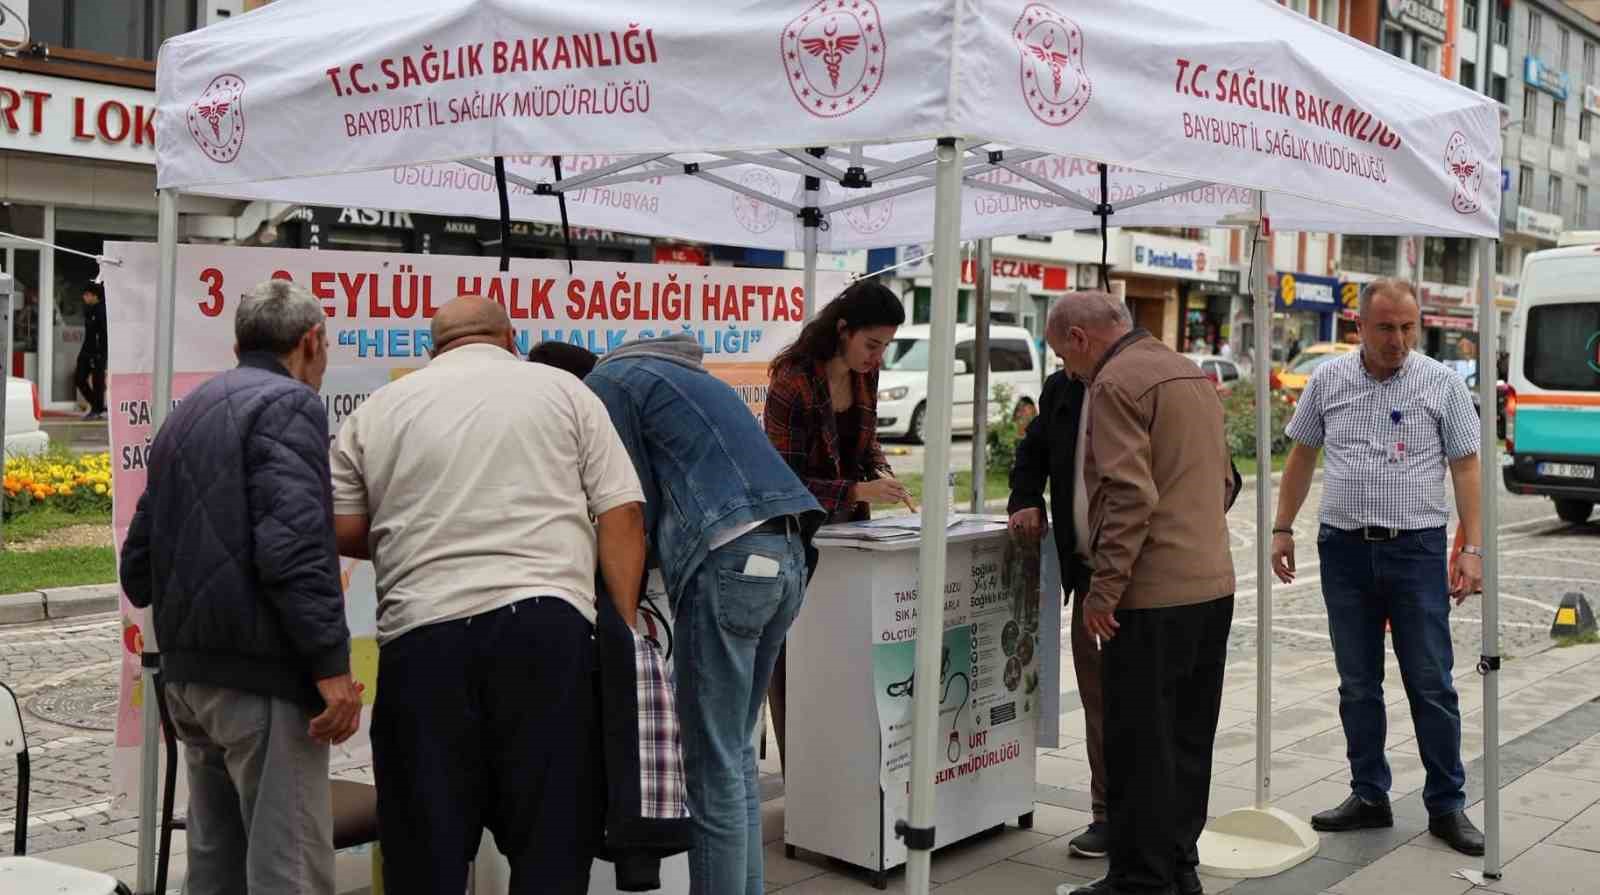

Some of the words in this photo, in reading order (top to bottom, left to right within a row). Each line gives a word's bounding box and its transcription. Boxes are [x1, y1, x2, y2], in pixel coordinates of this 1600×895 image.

[326, 62, 378, 98] T.C.
[384, 43, 483, 91] SAĞLIK
[492, 23, 658, 75] BAKANLIĞI
[1175, 58, 1210, 100] T.C.
[1215, 63, 1291, 117] SAĞLIK
[344, 103, 423, 137] BAYBURT
[427, 97, 445, 126] İL
[449, 91, 507, 124] SAĞLIK
[512, 80, 651, 118] MÜDÜRLÜĞÜ
[1182, 112, 1248, 145] BAYBURT
[1250, 121, 1263, 152] İL
[1265, 128, 1312, 156] SAĞLIK
[1312, 140, 1387, 184] MÜDÜRLÜĞÜ
[566, 271, 692, 321] SAĞLIĞI
